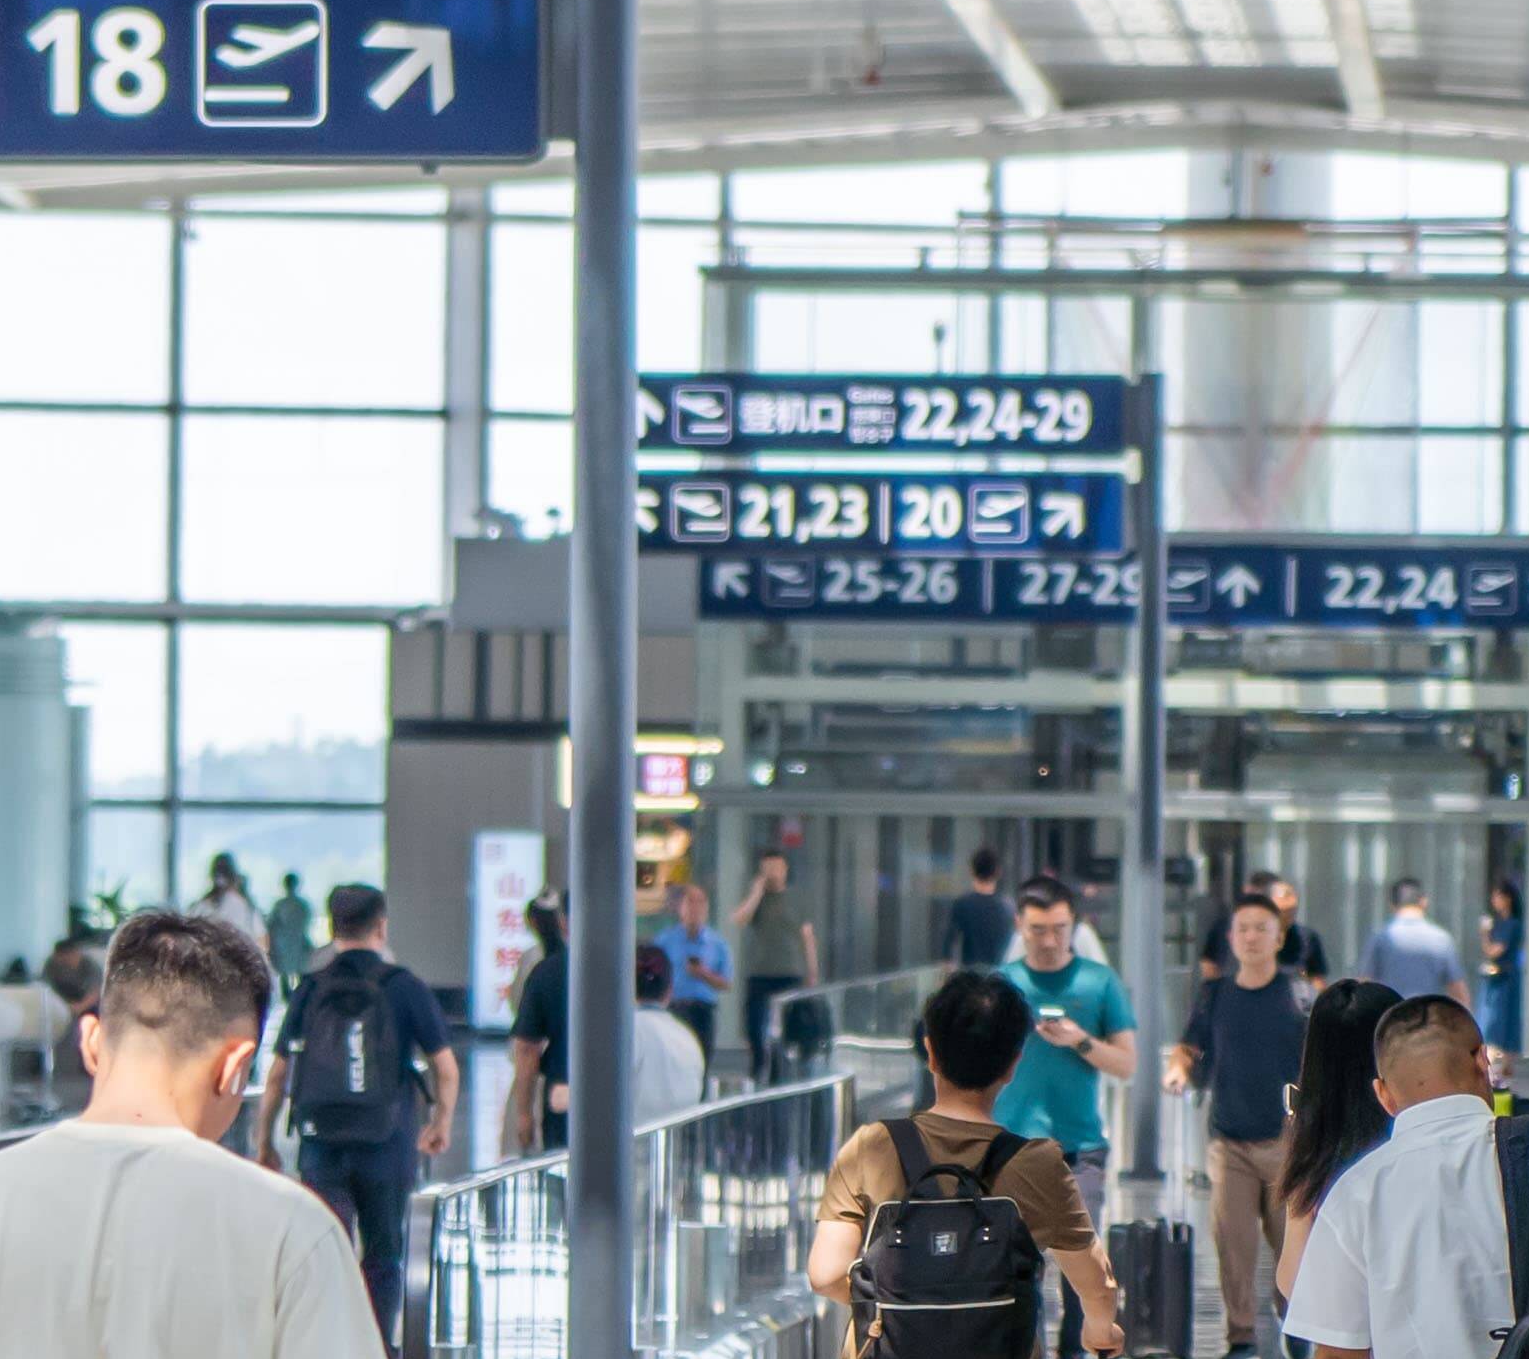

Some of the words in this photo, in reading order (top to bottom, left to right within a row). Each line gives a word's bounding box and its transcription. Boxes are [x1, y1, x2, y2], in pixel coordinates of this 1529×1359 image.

[29, 8, 166, 116] 18
[739, 393, 844, 434] 登机口
[902, 389, 1092, 447] 22,24-29
[739, 485, 869, 543] 21,23
[900, 485, 963, 539] 20
[824, 564, 958, 603] 25-26
[1324, 566, 1459, 613] 22,24
